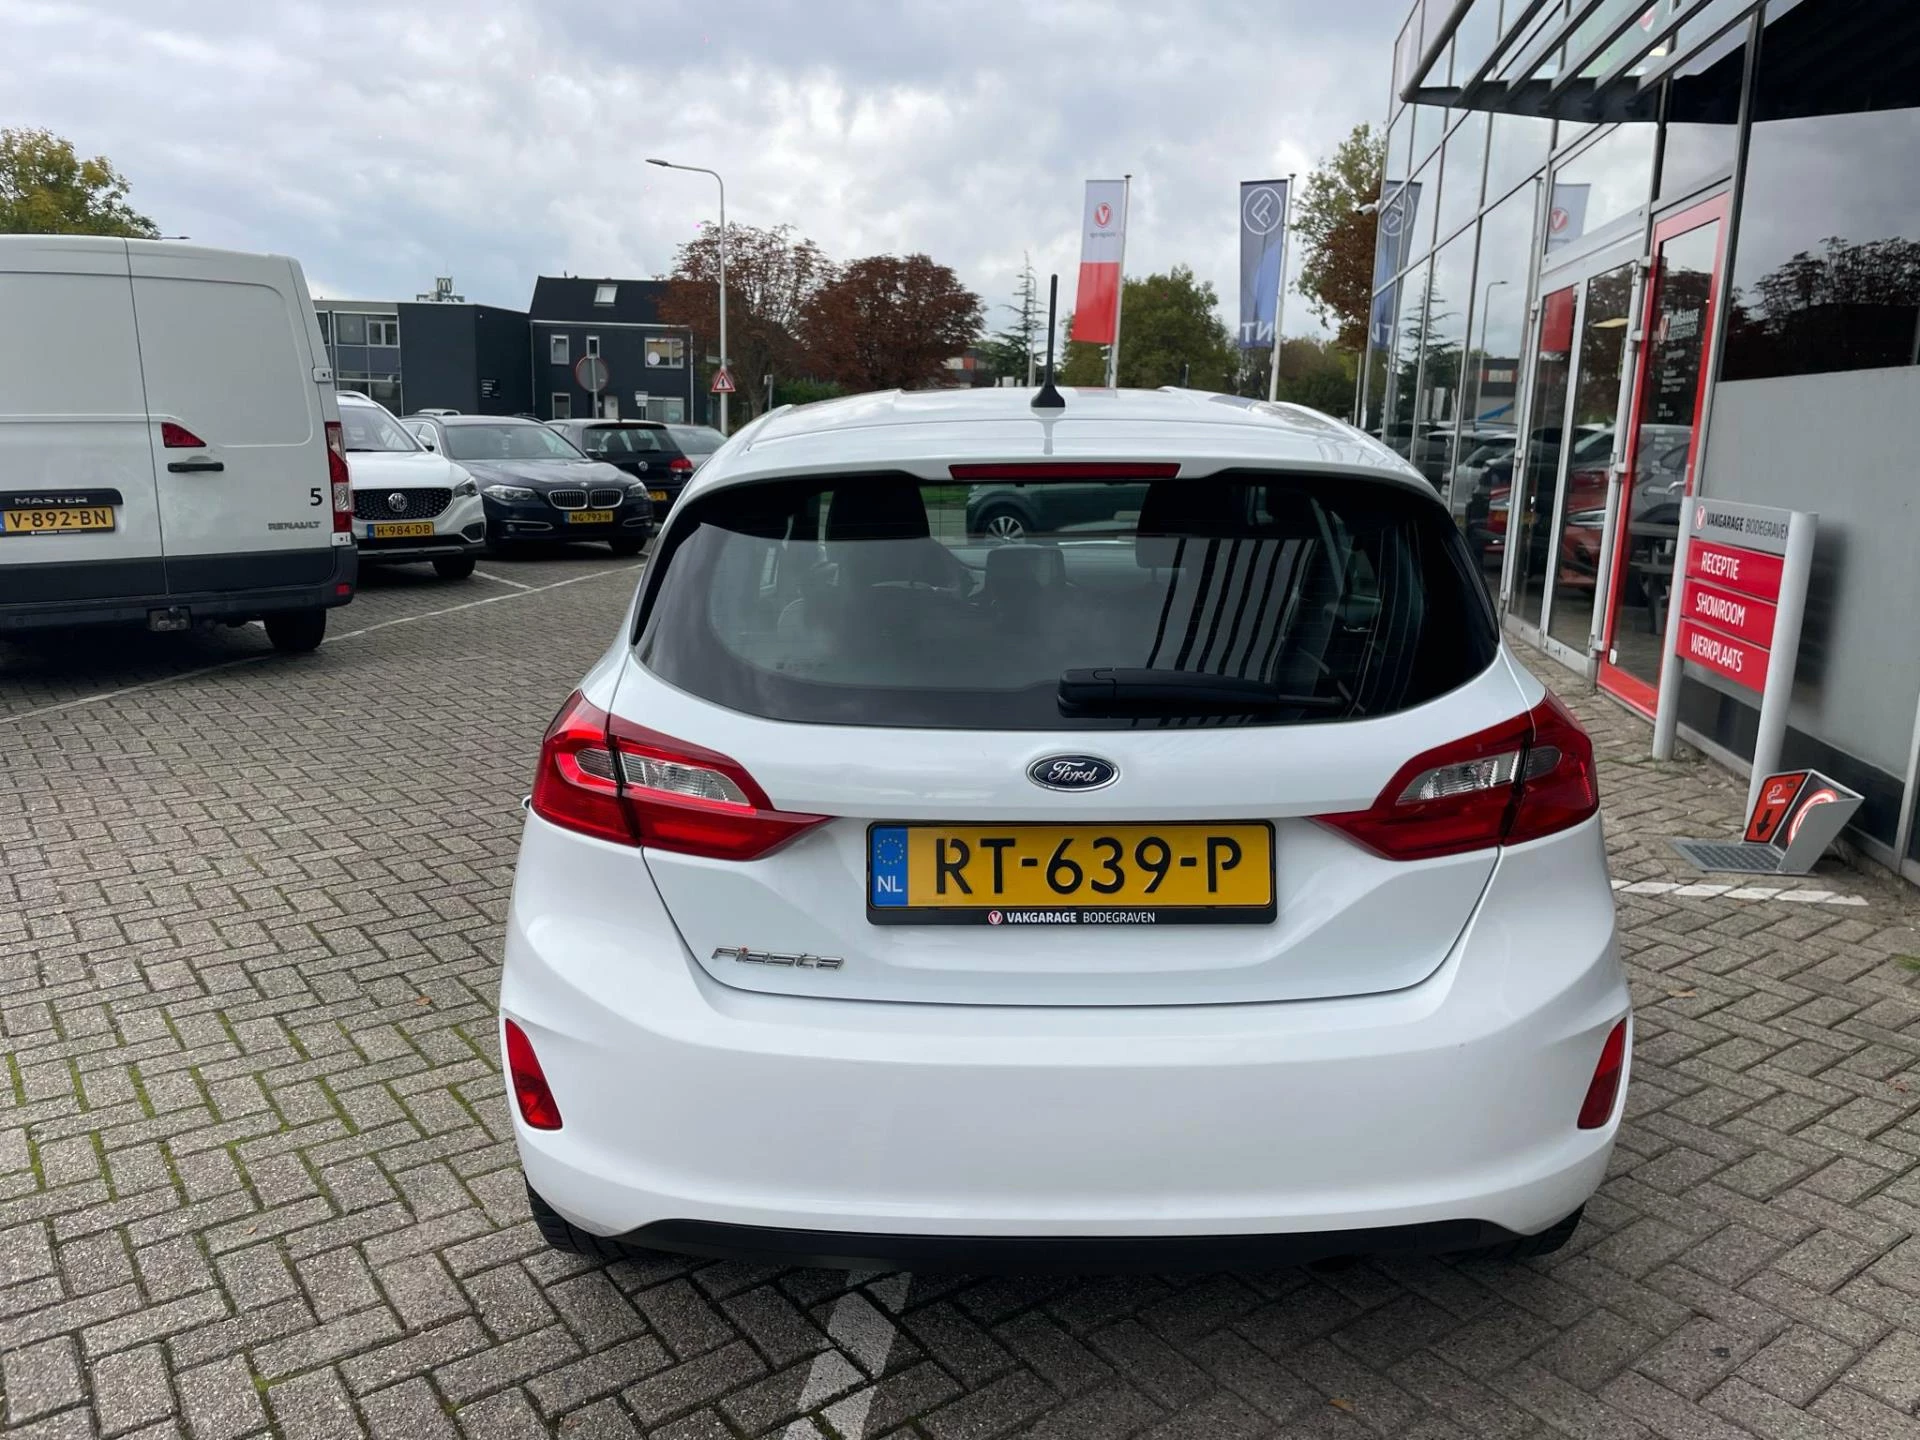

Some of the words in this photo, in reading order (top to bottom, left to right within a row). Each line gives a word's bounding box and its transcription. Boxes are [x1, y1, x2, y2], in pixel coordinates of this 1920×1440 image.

[310, 488, 323, 506] 5
[10, 510, 107, 528] V-892-BN
[268, 521, 320, 530] RENAULT
[1707, 512, 1744, 532] VAKGARAGE
[1745, 518, 1788, 540] BODEGRAVEN
[377, 525, 431, 536] H-984-DB
[1701, 552, 1739, 580] RECEPTIE
[1695, 592, 1746, 628] SHOWROOM
[1690, 632, 1743, 673] WERKPLAATS
[1047, 761, 1098, 782] Ford
[935, 836, 1242, 895] RT-639-P
[877, 876, 903, 892] NL
[1006, 912, 1077, 923] VAKGARAGE
[1082, 912, 1156, 923] BODEGRAVEN
[711, 945, 844, 969] Fiesta
